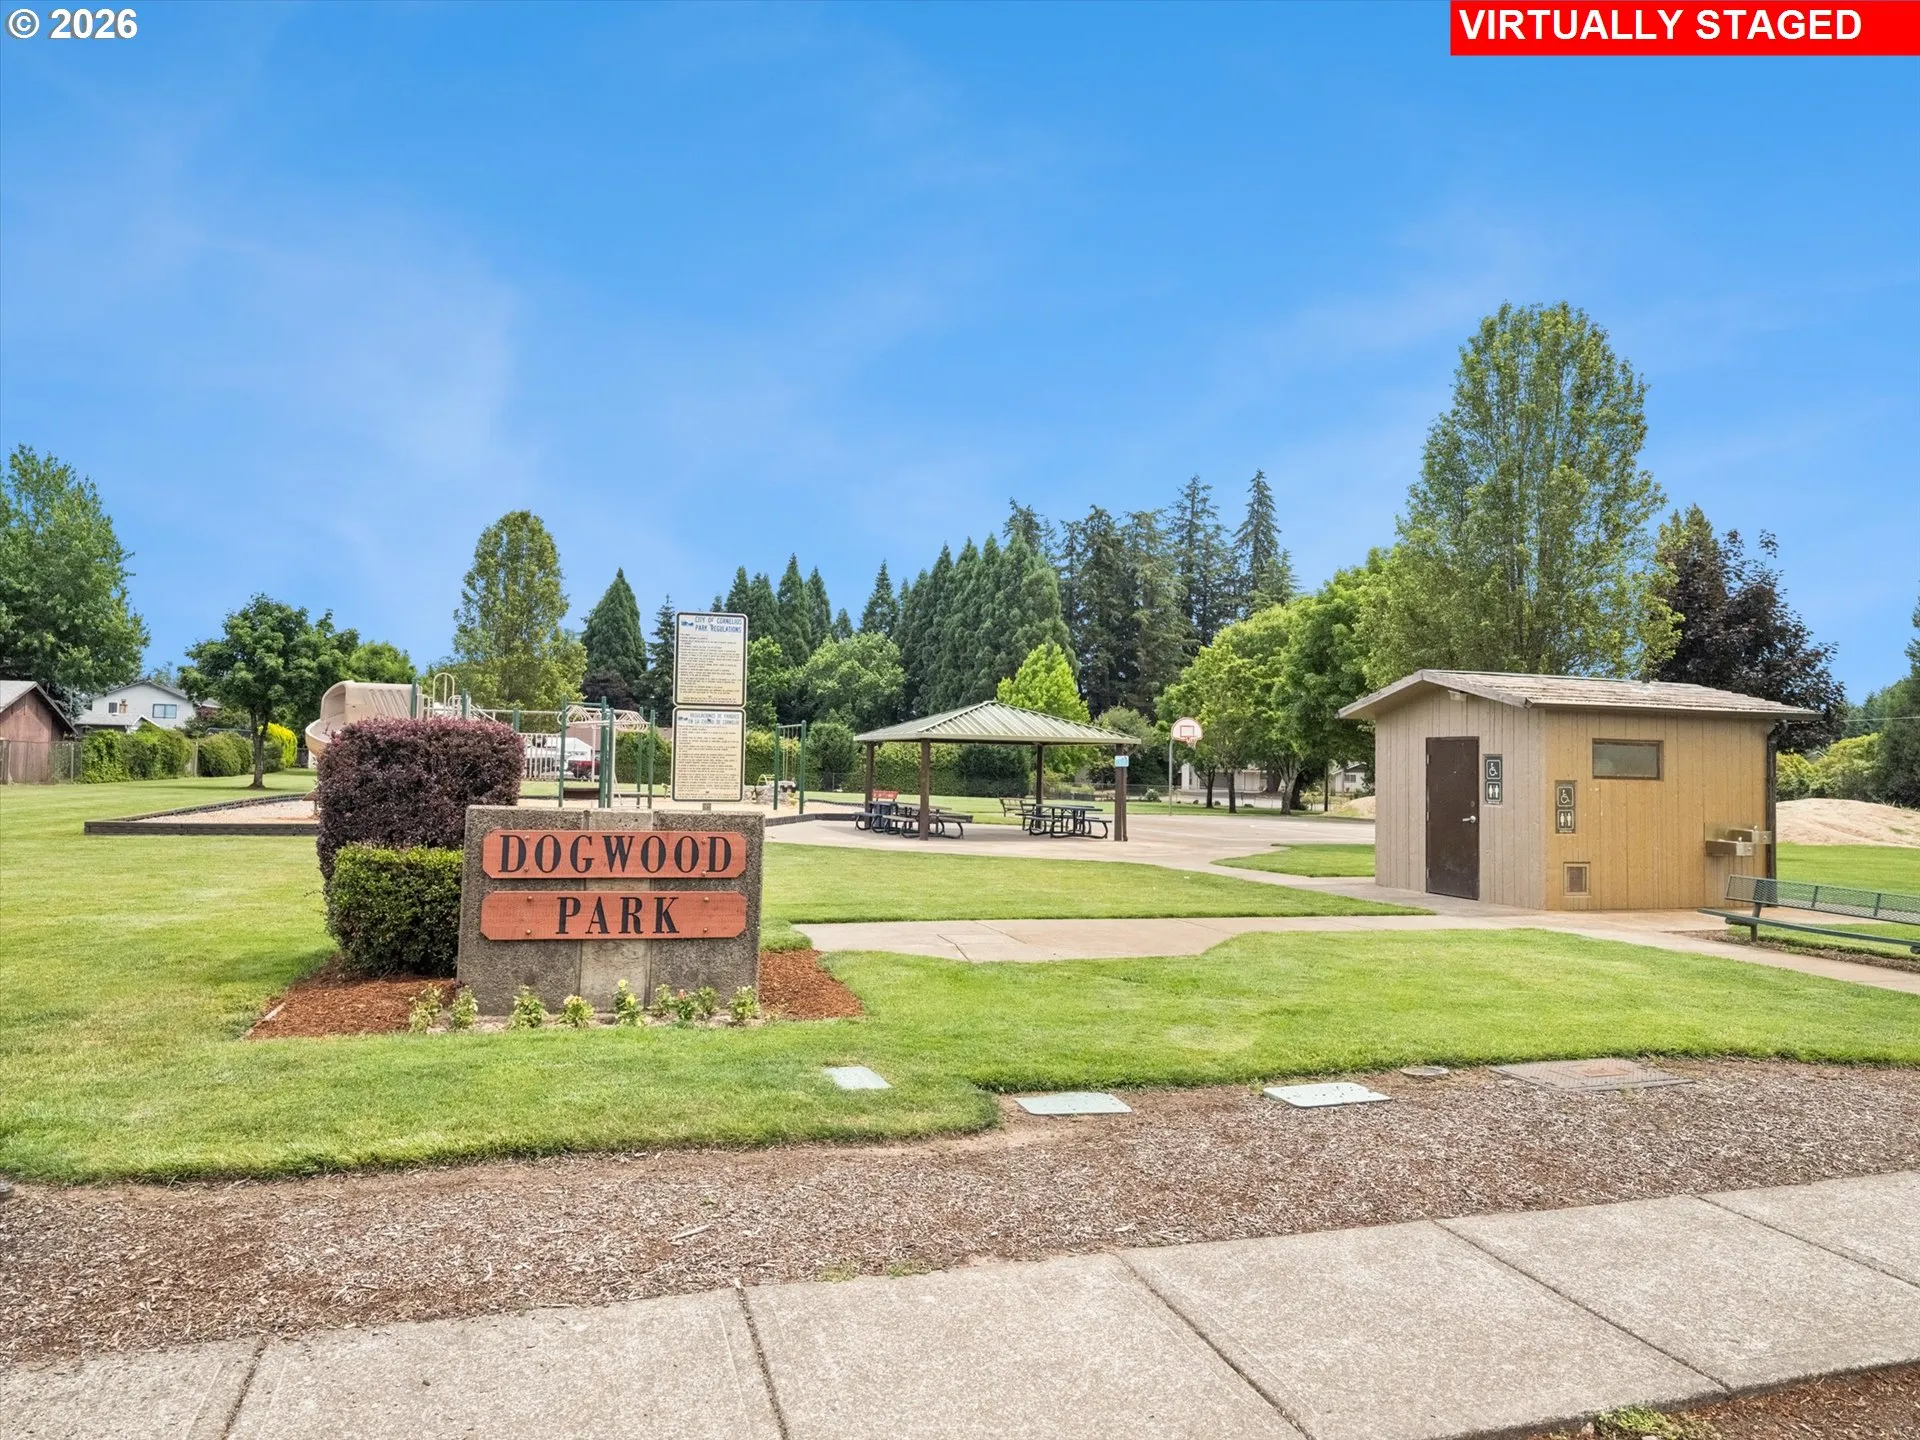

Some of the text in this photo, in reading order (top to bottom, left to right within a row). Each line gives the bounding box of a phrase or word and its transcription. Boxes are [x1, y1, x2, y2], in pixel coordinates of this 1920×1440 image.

[710, 624, 742, 633] REGULATIONS
[498, 834, 732, 874] DOGWOOD
[555, 895, 681, 935] PARK
